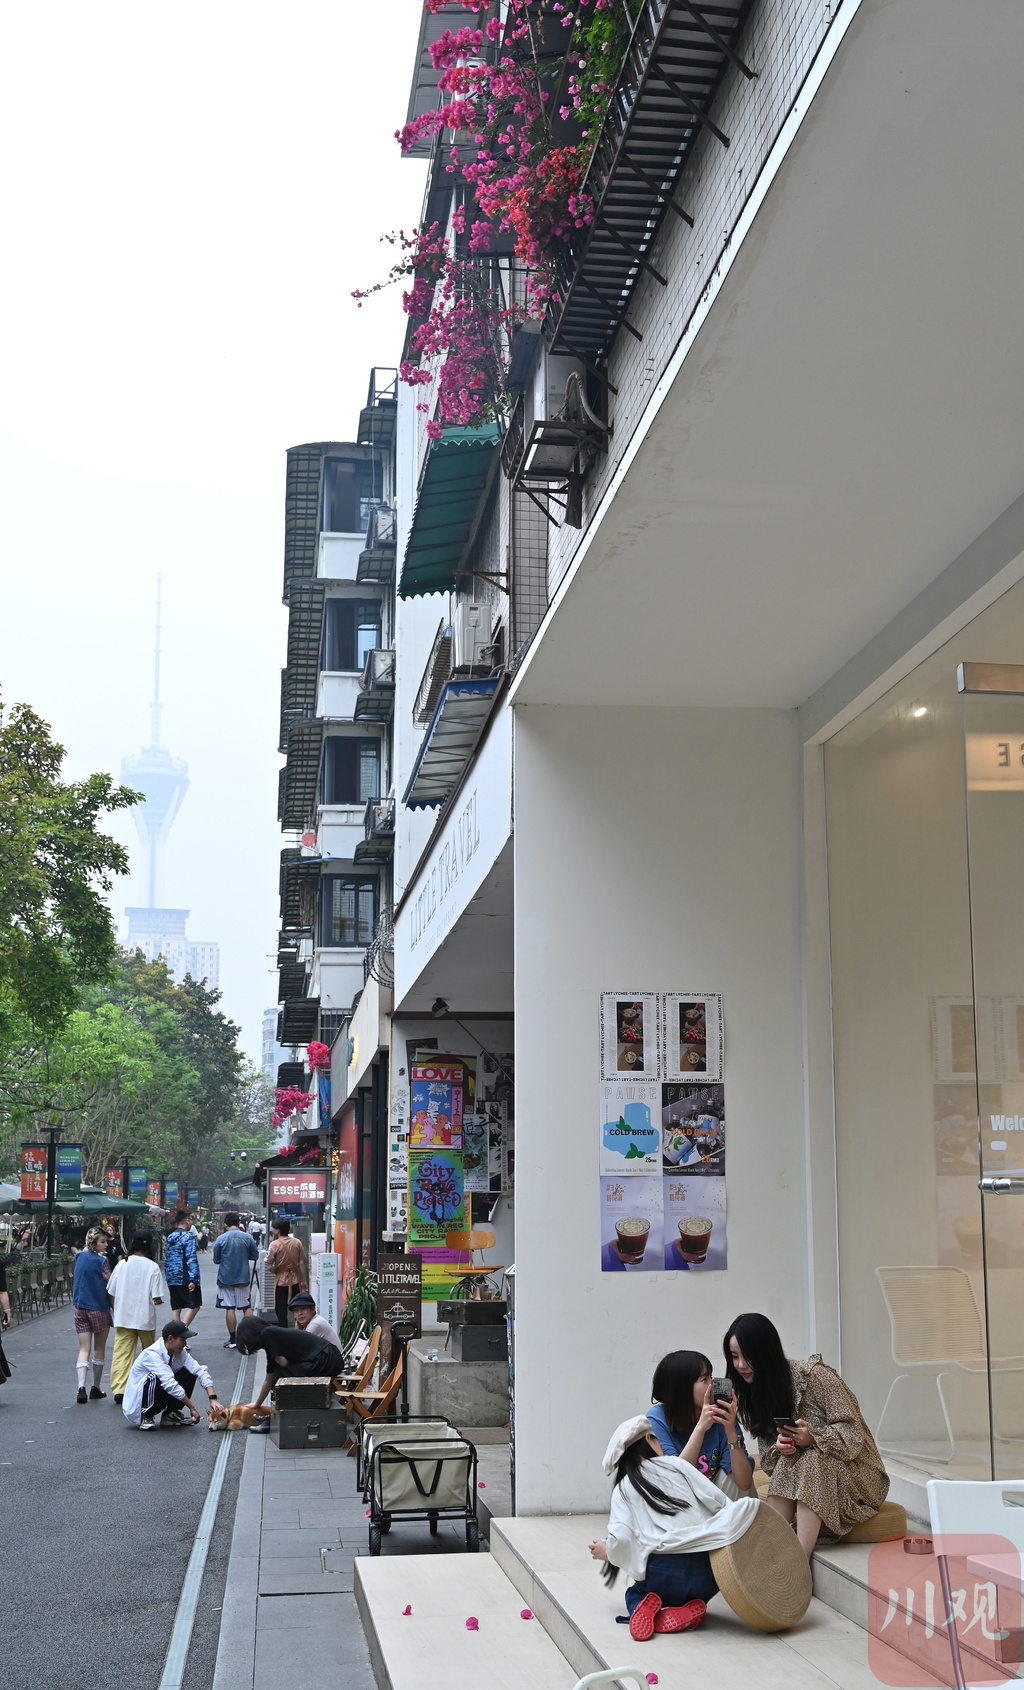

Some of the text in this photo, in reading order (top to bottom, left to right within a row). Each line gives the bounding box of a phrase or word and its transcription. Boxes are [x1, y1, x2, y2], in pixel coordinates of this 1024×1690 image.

[411, 866, 436, 952] LITTLE
[438, 788, 480, 904] TRAVEL
[413, 1068, 462, 1080] LOVE
[418, 1161, 455, 1182] City
[273, 1186, 300, 1195] ESSE
[378, 1274, 421, 1284] LITTLETRAVEL
